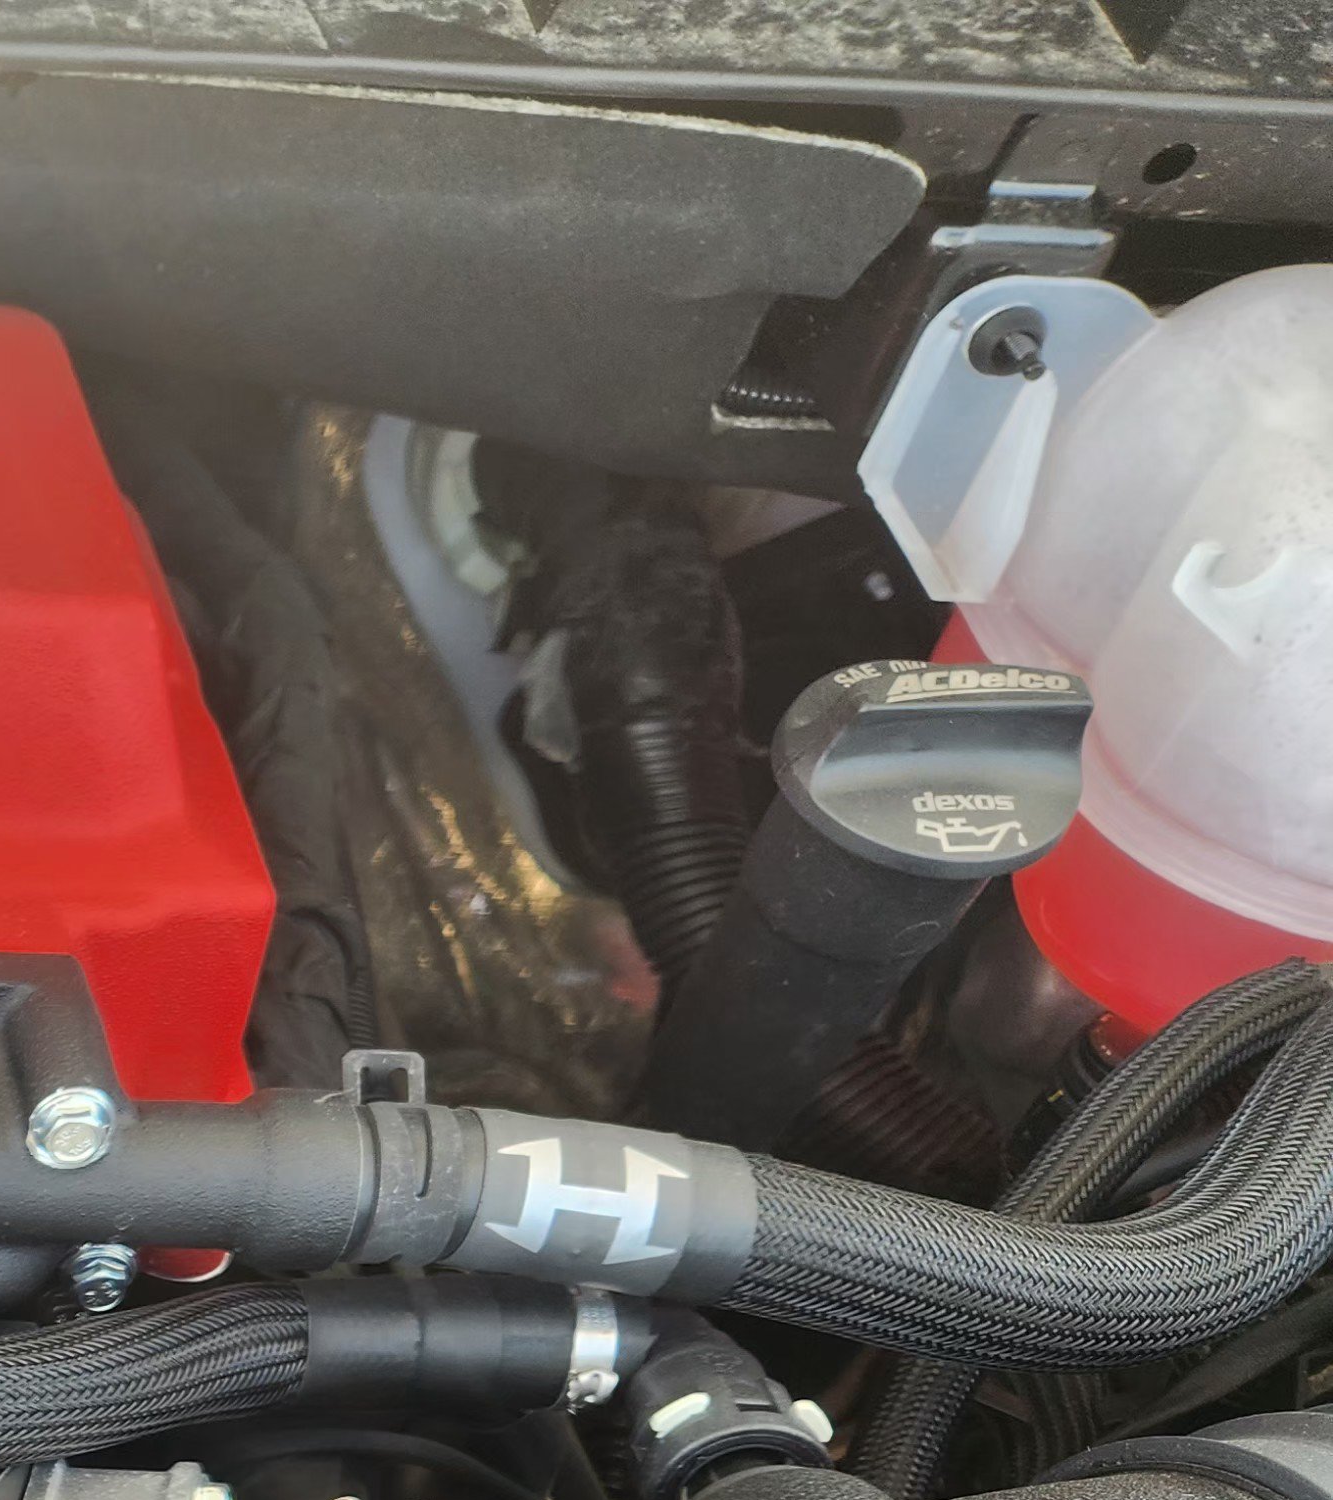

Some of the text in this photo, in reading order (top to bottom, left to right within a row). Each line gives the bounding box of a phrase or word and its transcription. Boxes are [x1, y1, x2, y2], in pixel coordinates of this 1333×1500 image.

[833, 664, 883, 687] SAE
[886, 669, 1071, 697] ACDelco
[911, 791, 1015, 812] dexos
